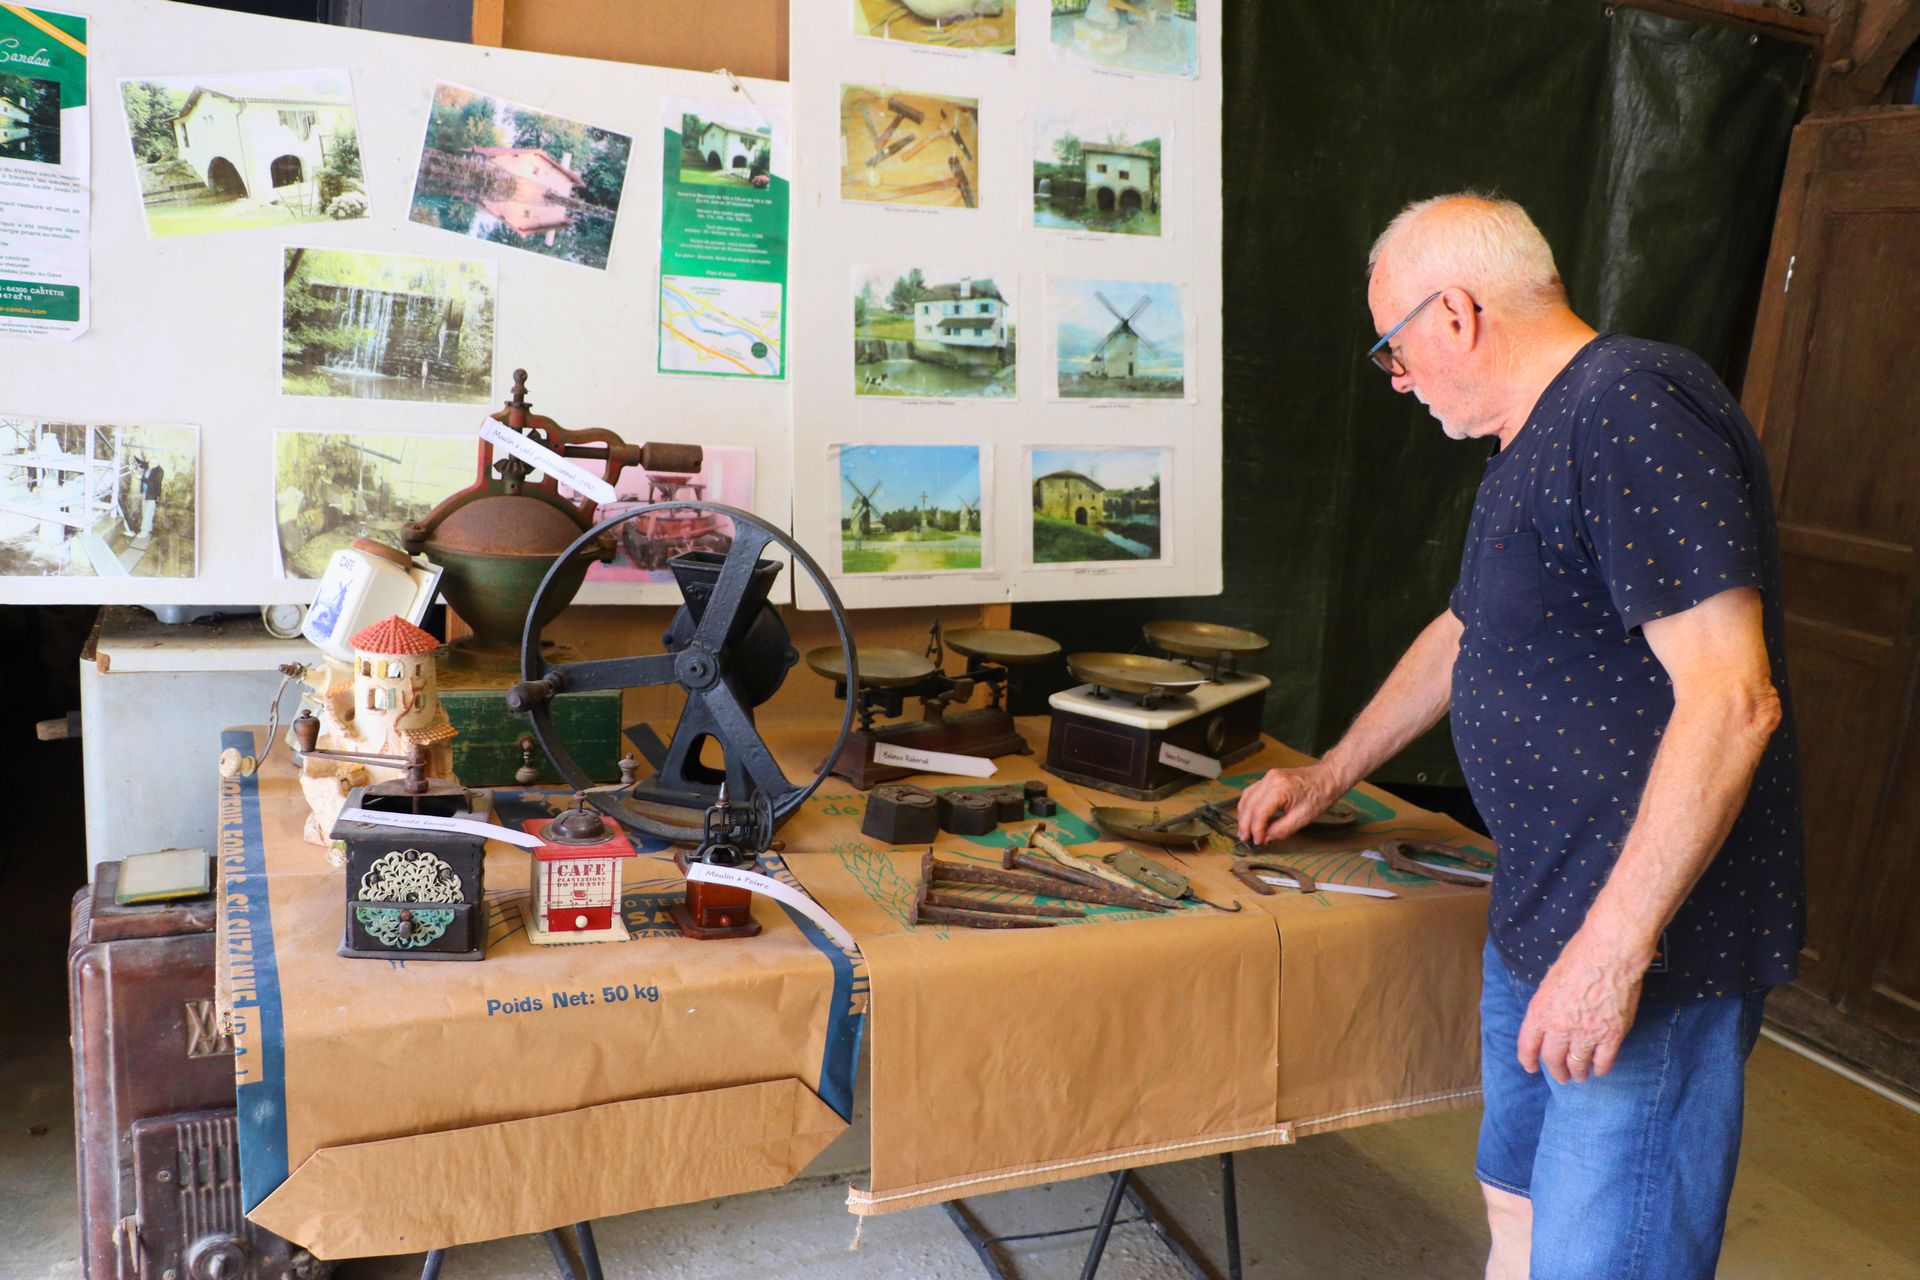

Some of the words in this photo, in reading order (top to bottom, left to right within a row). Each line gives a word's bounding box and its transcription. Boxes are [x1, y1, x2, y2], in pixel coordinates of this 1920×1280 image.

[557, 863, 606, 877] CAFE
[705, 869, 734, 881] Moulin
[745, 876, 769, 890] Poivre
[487, 996, 543, 1016] Poids
[552, 991, 596, 1009] Net:
[602, 985, 629, 1004] 50
[633, 984, 659, 1003] kg
